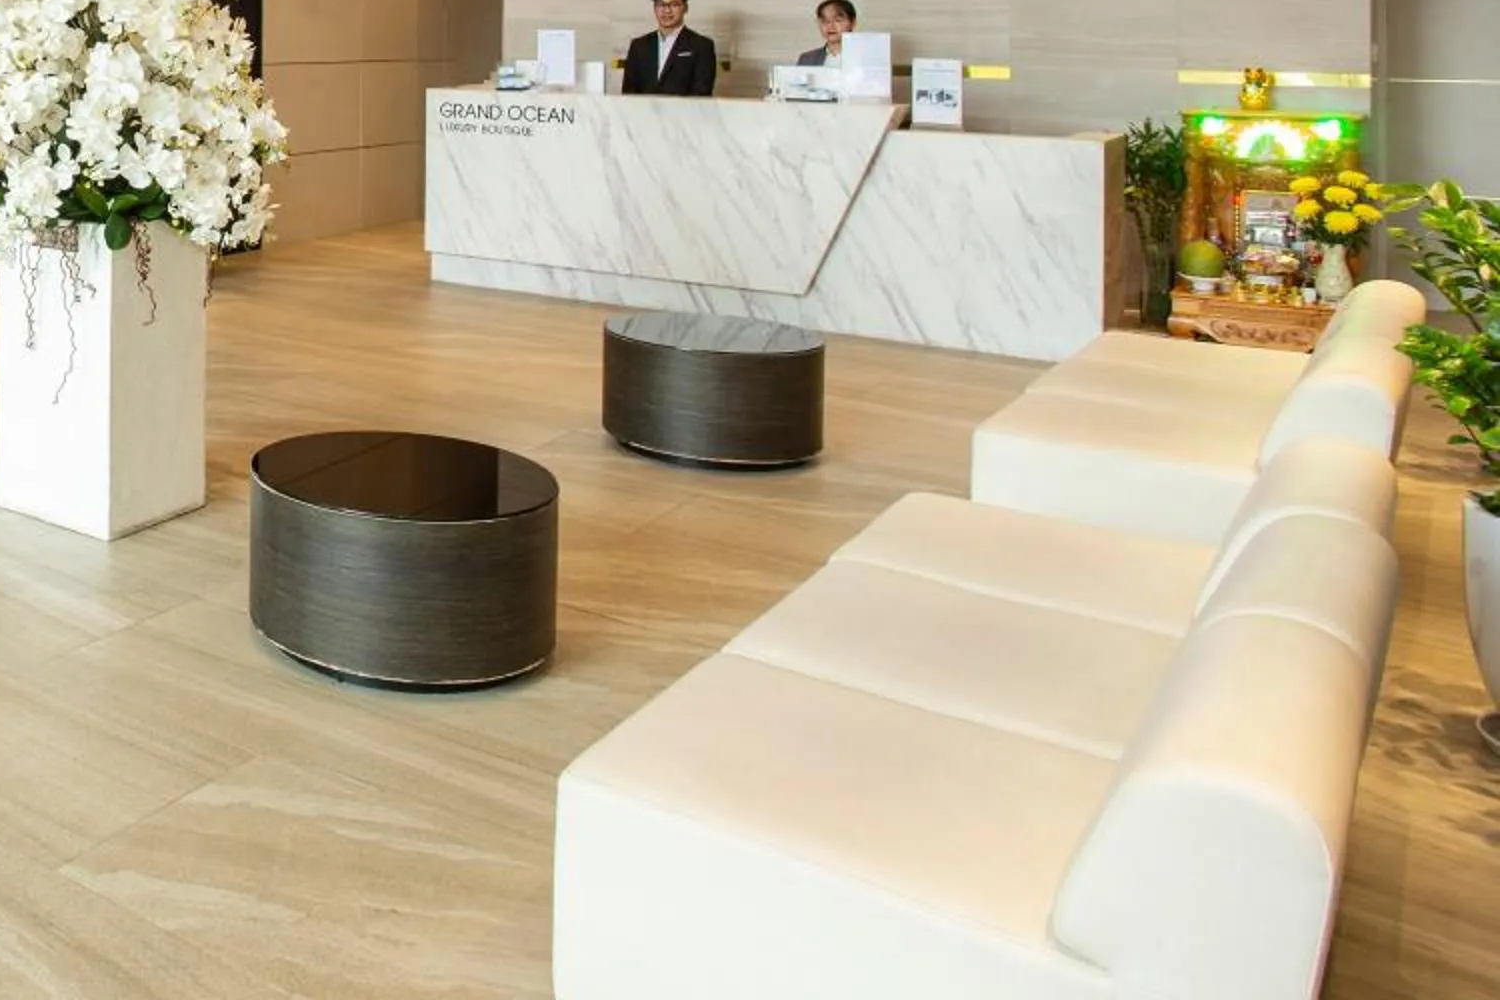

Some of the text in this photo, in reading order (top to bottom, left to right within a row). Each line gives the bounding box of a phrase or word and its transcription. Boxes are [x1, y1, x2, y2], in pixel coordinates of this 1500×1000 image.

[439, 101, 576, 124] GRAND OCEAN
[481, 123, 535, 137] BOUTIQUE
